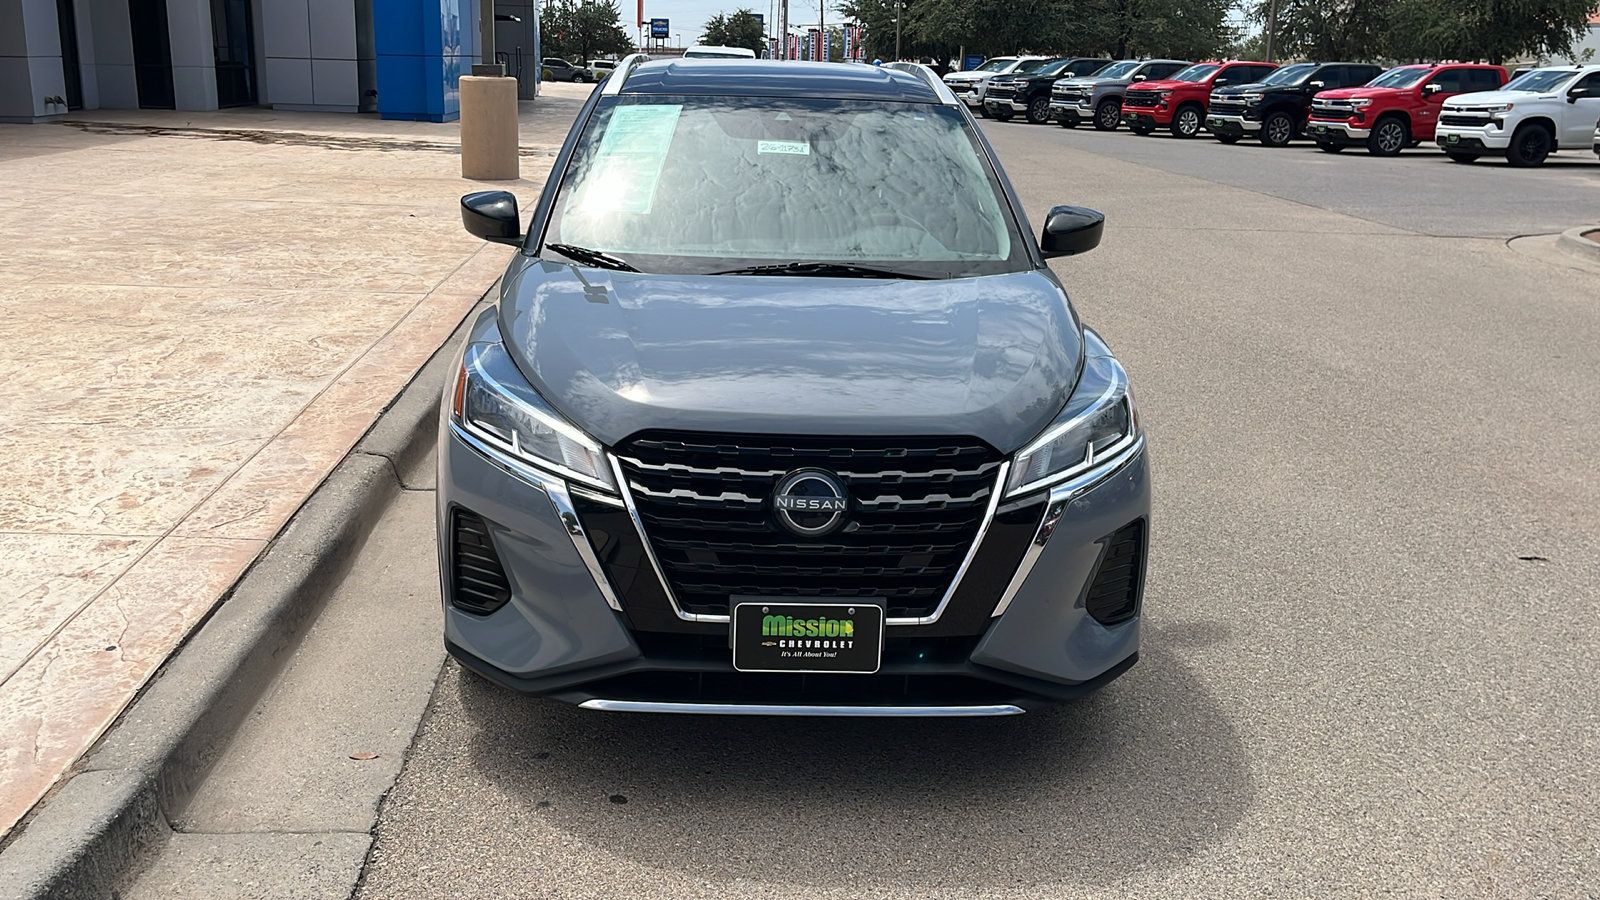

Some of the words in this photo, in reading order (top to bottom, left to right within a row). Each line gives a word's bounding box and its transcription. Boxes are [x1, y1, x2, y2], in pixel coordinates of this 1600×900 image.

[776, 497, 846, 509] NISSAN
[762, 615, 854, 637] Mission
[779, 640, 853, 649] CHEVROLET
